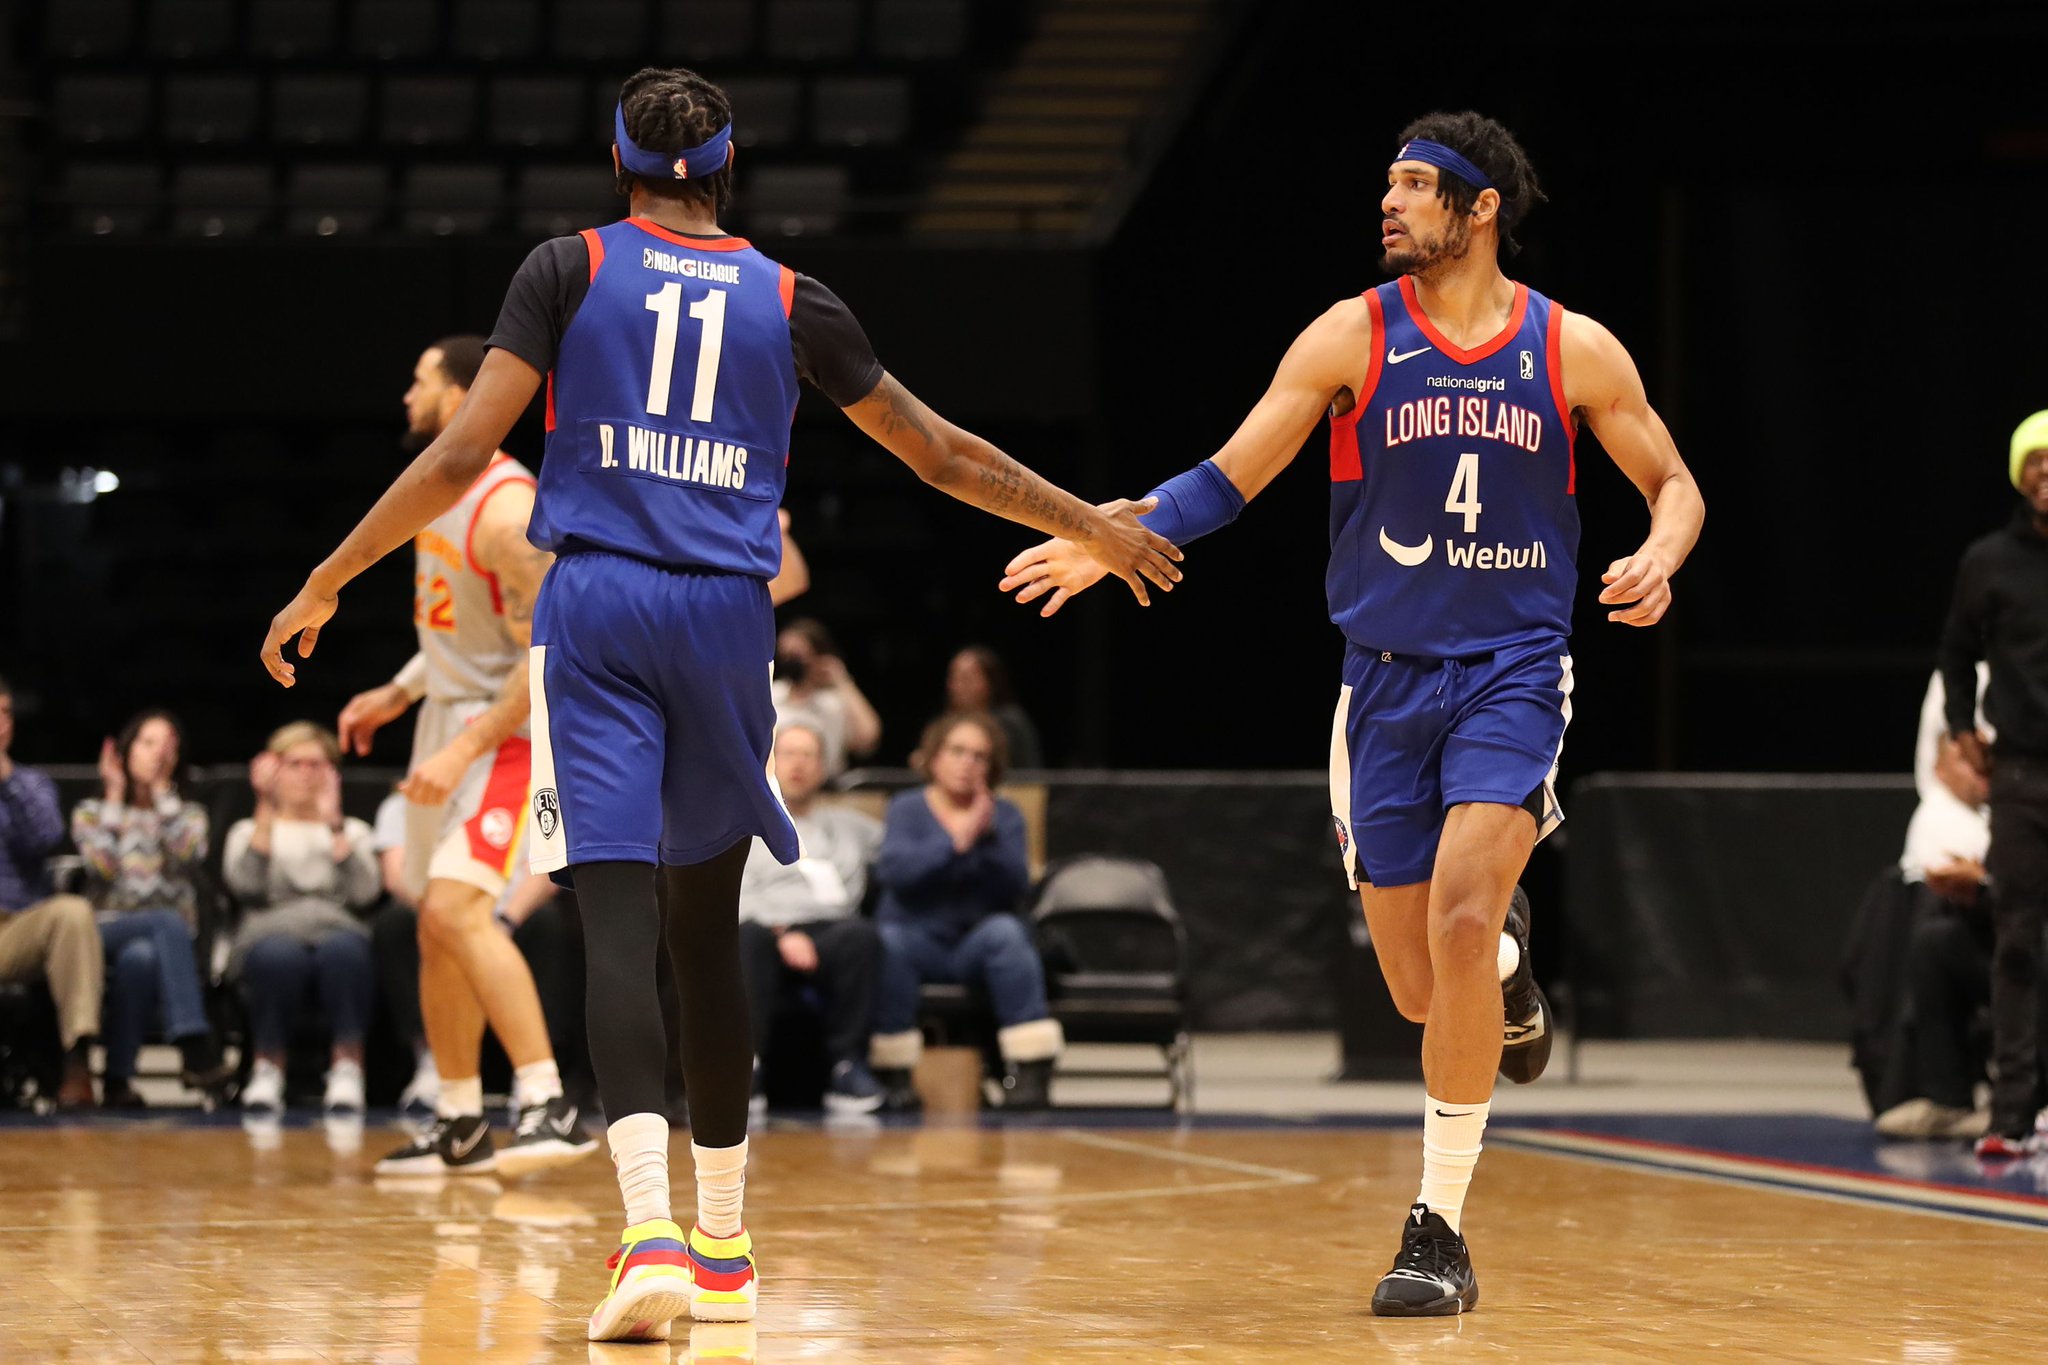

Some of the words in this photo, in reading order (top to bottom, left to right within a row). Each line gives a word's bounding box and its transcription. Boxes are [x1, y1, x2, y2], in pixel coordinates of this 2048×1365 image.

[654, 251, 678, 274] NBA
[678, 259, 697, 277] G
[697, 261, 740, 284] LEAGUE
[645, 281, 727, 423] 11
[1427, 375, 1505, 392] nationalgrid
[1386, 396, 1450, 447] LONG
[1458, 396, 1542, 452] ISLAND
[599, 424, 619, 468] D.
[628, 425, 748, 490] WILLIAMS
[1445, 453, 1482, 533] 4
[1446, 539, 1547, 569] Webull
[534, 791, 557, 815] NETS
